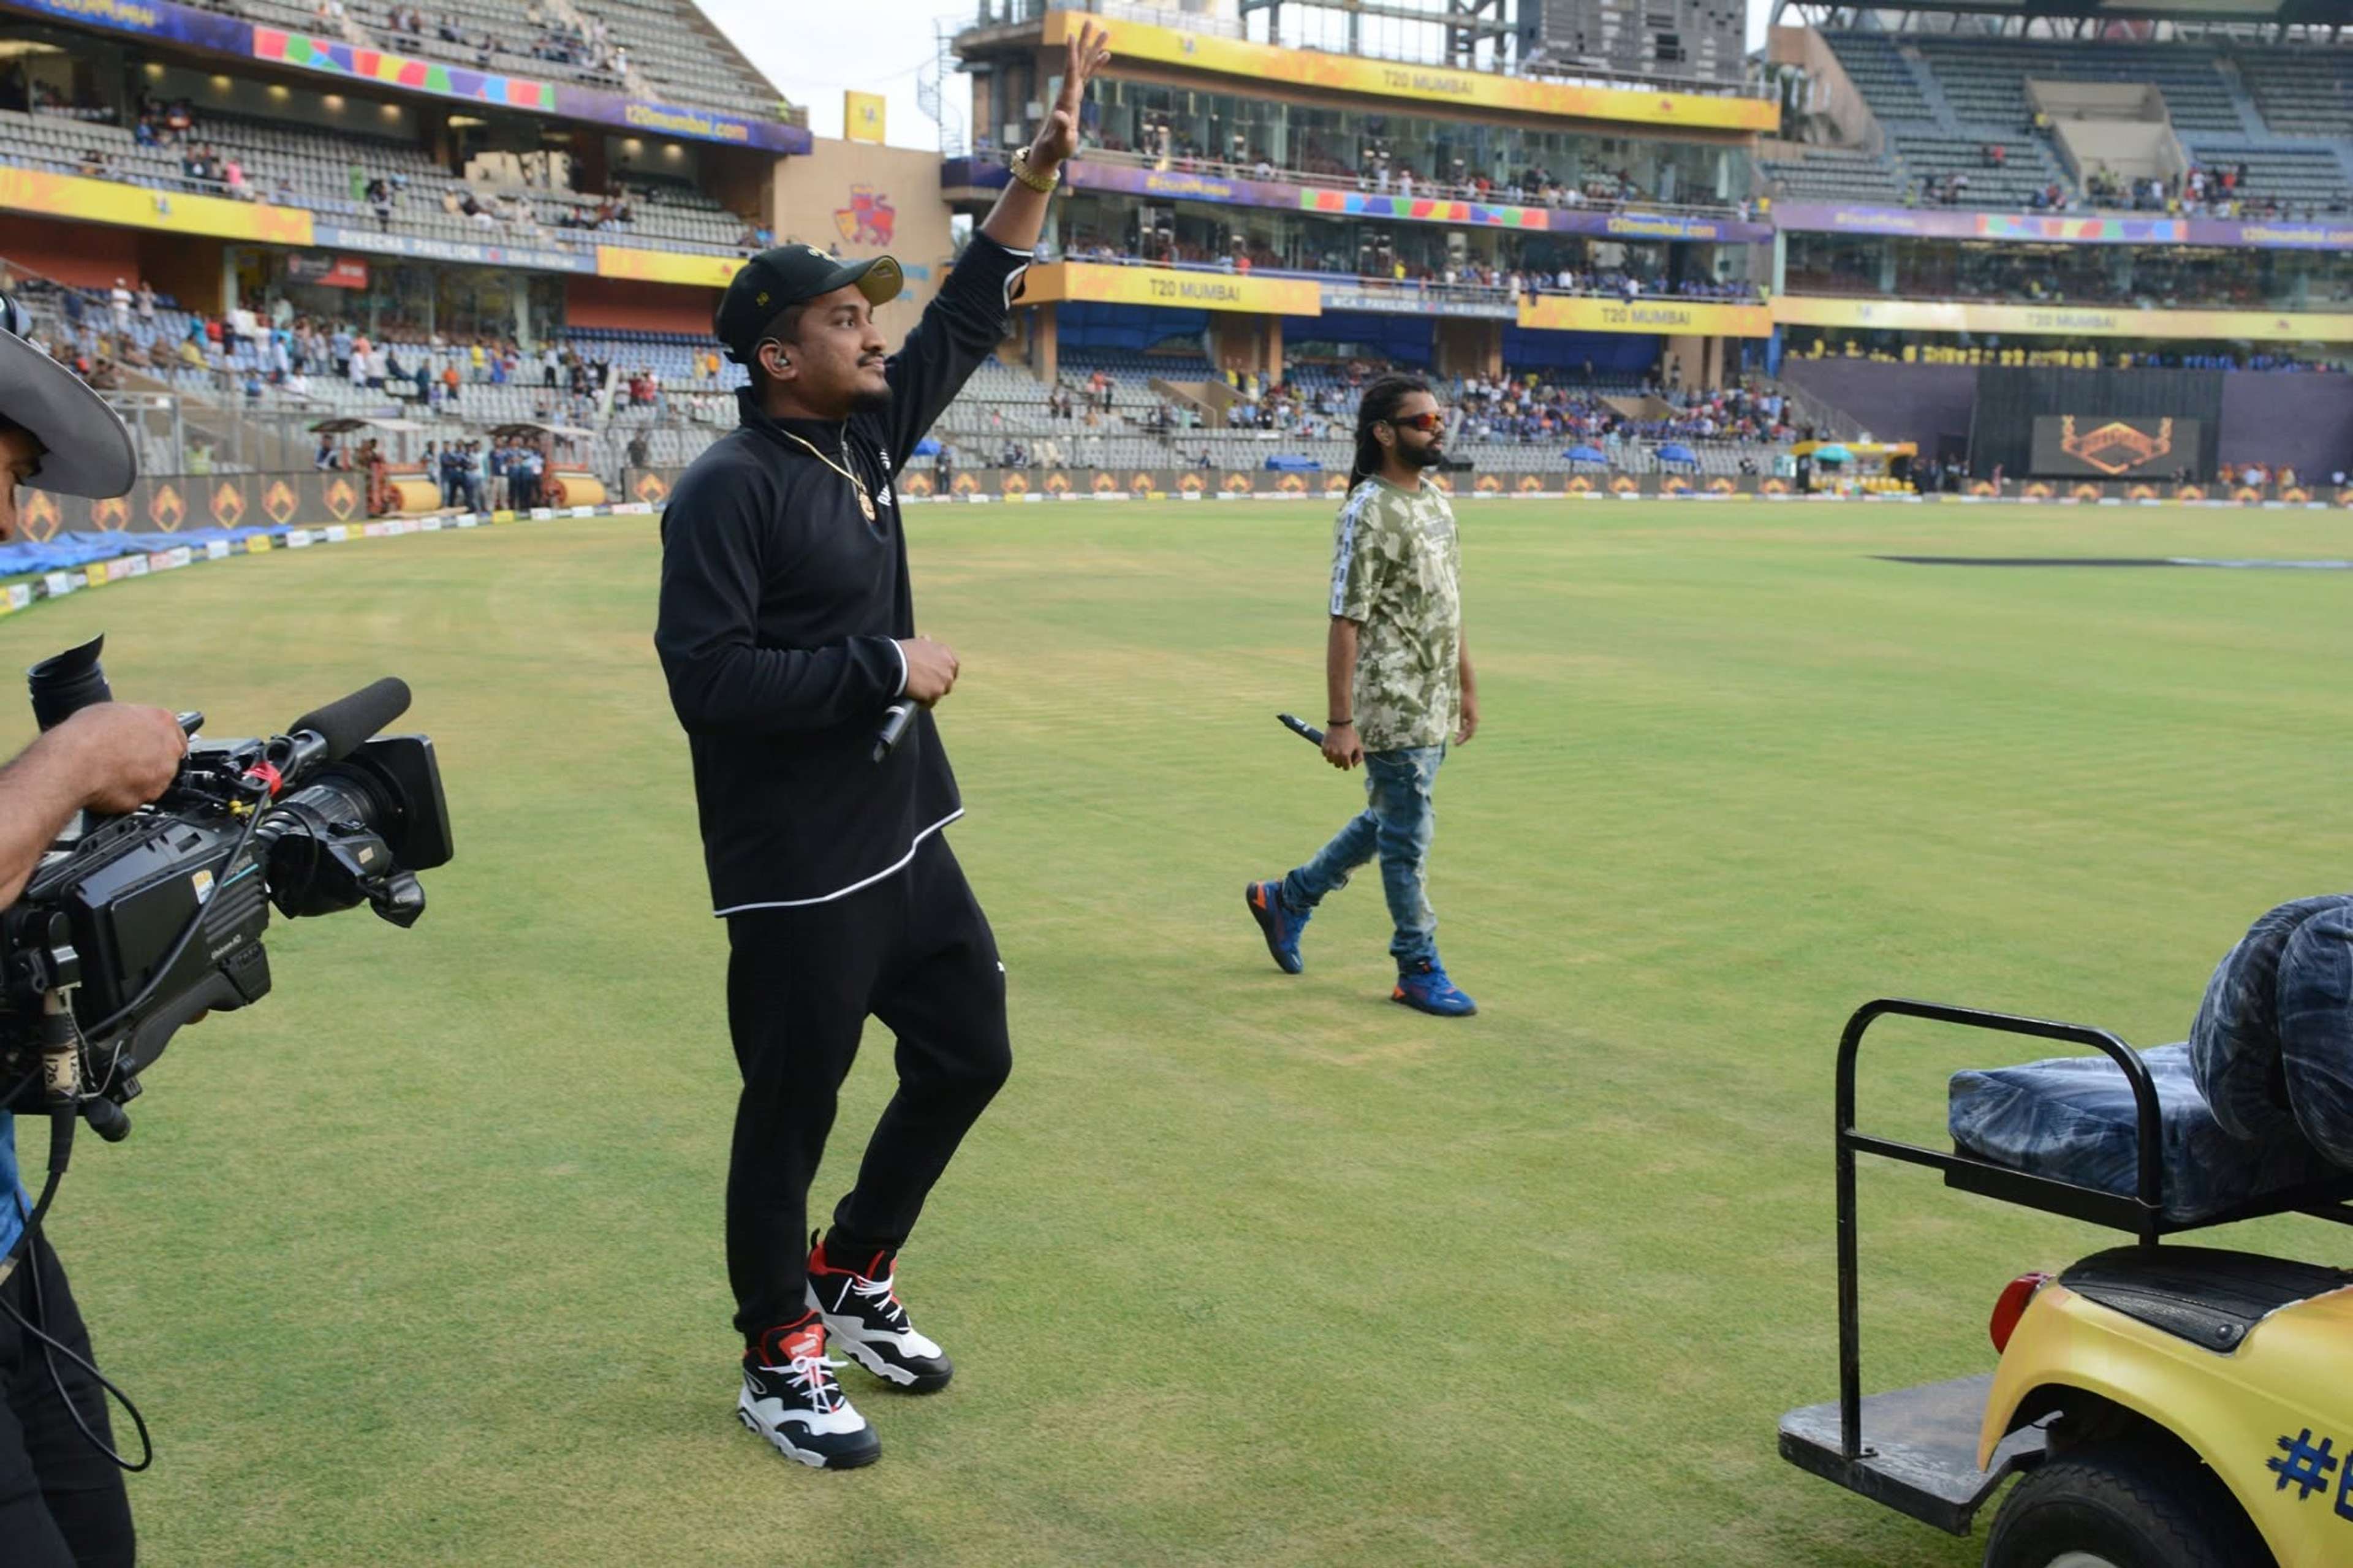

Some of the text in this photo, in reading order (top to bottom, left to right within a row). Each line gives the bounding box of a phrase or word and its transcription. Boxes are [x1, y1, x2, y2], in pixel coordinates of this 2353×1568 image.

[1412, 73, 1474, 95] MUMBAI
[1150, 278, 1241, 302] T20 MUMBAI
[1601, 308, 1691, 325] T20 MUMBAI
